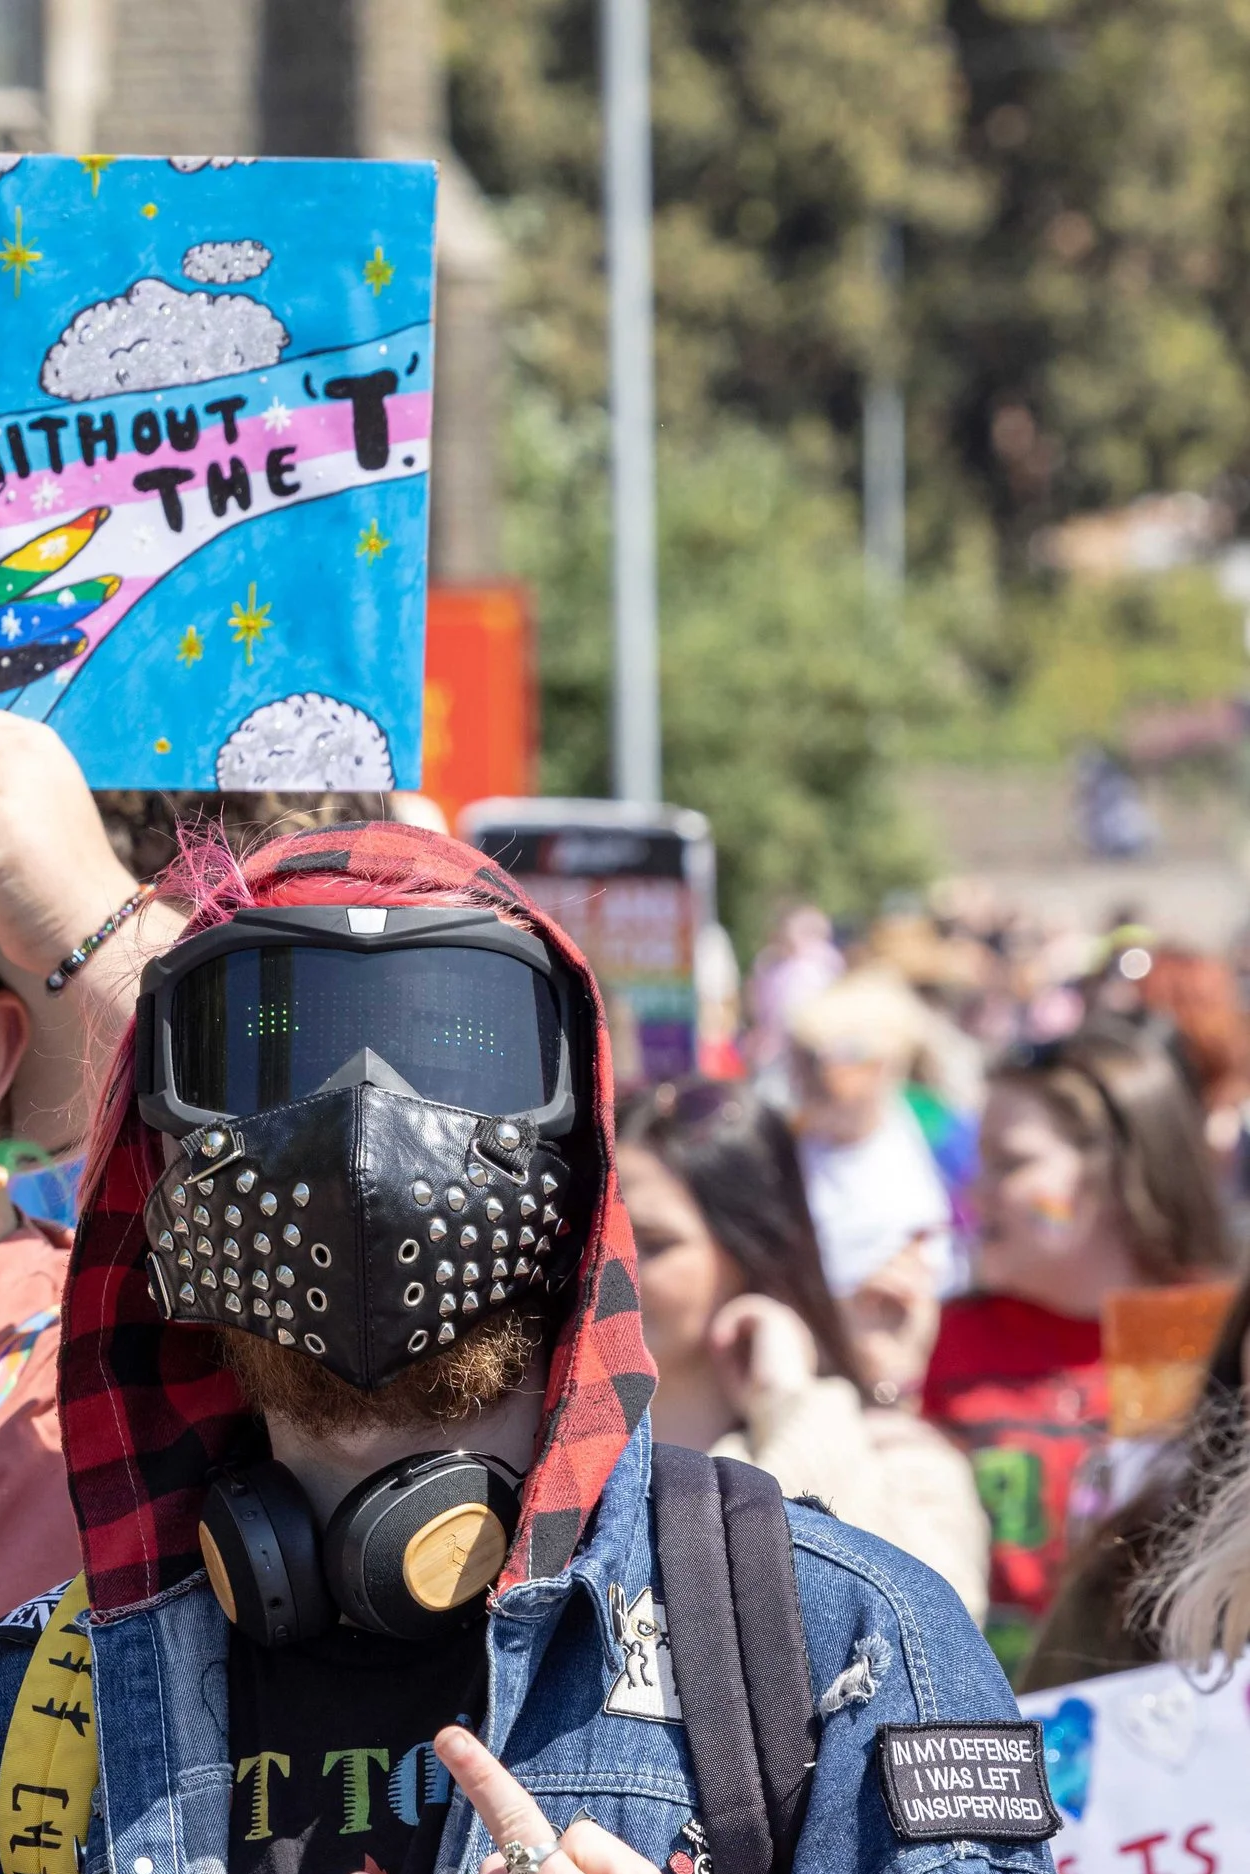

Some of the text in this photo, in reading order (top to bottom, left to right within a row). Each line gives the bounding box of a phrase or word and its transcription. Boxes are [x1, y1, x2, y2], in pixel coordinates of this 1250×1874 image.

[134, 448, 301, 532] THE
[892, 1738, 1032, 1765] IN MY DEFENSE
[914, 1766, 1021, 1793] I WAS LEFT
[903, 1796, 1043, 1822] UNSUPERVISED
